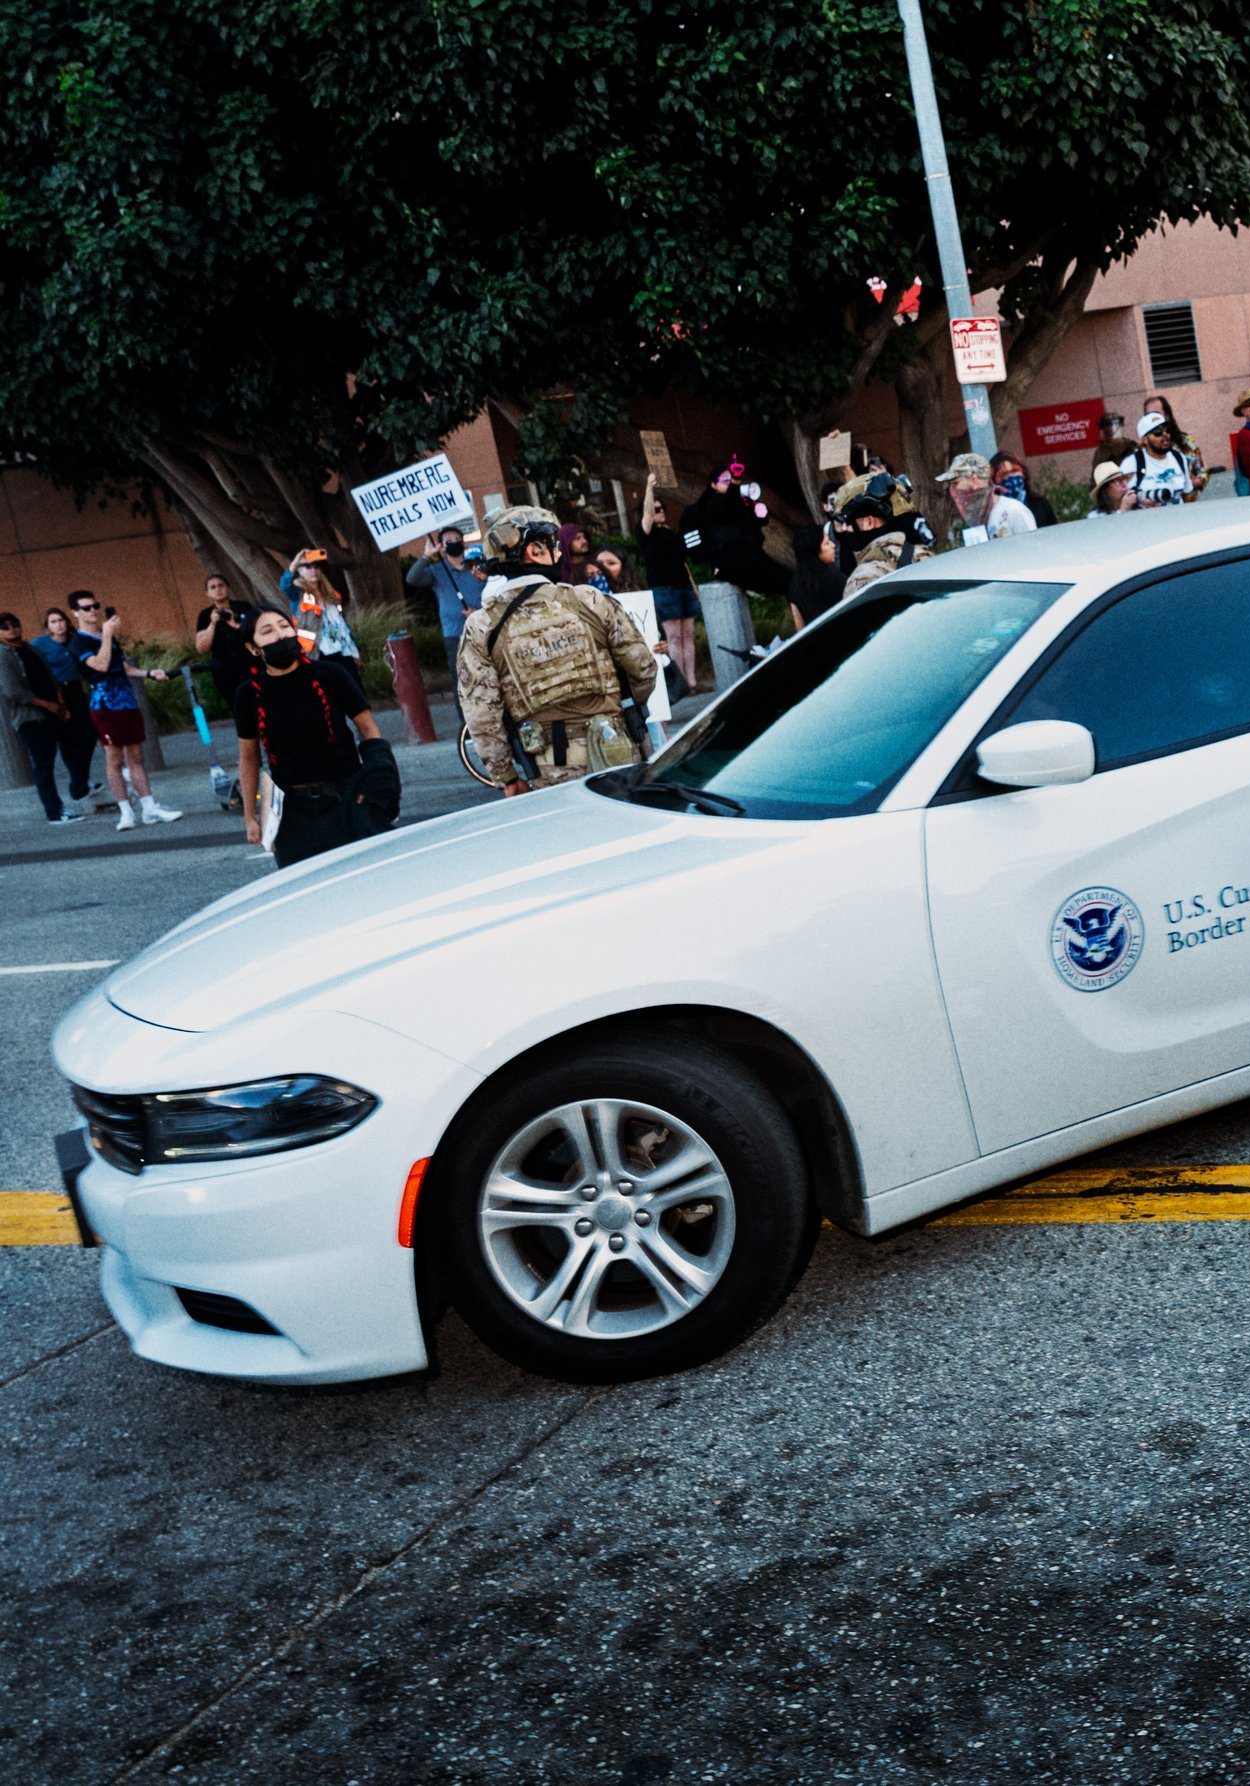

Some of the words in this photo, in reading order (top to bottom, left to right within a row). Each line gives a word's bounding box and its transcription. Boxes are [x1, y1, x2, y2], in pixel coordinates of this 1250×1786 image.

[954, 332, 970, 348] NO
[970, 334, 999, 346] STOPPING
[963, 350, 977, 360] ANY
[980, 349, 997, 360] TIME
[1036, 420, 1090, 436] EMERGENCY
[1055, 412, 1069, 423] NO
[1044, 430, 1087, 444] SERVICES
[359, 462, 450, 514] NUREMBERG
[370, 503, 423, 536] TRIALS
[427, 490, 457, 514] NOW
[1063, 891, 1129, 917] DEPARTMENT
[1163, 895, 1213, 924] U.S.
[1167, 916, 1246, 954] Border
[1058, 954, 1105, 987] HOMELAND
[1109, 935, 1141, 981] SECURITY
